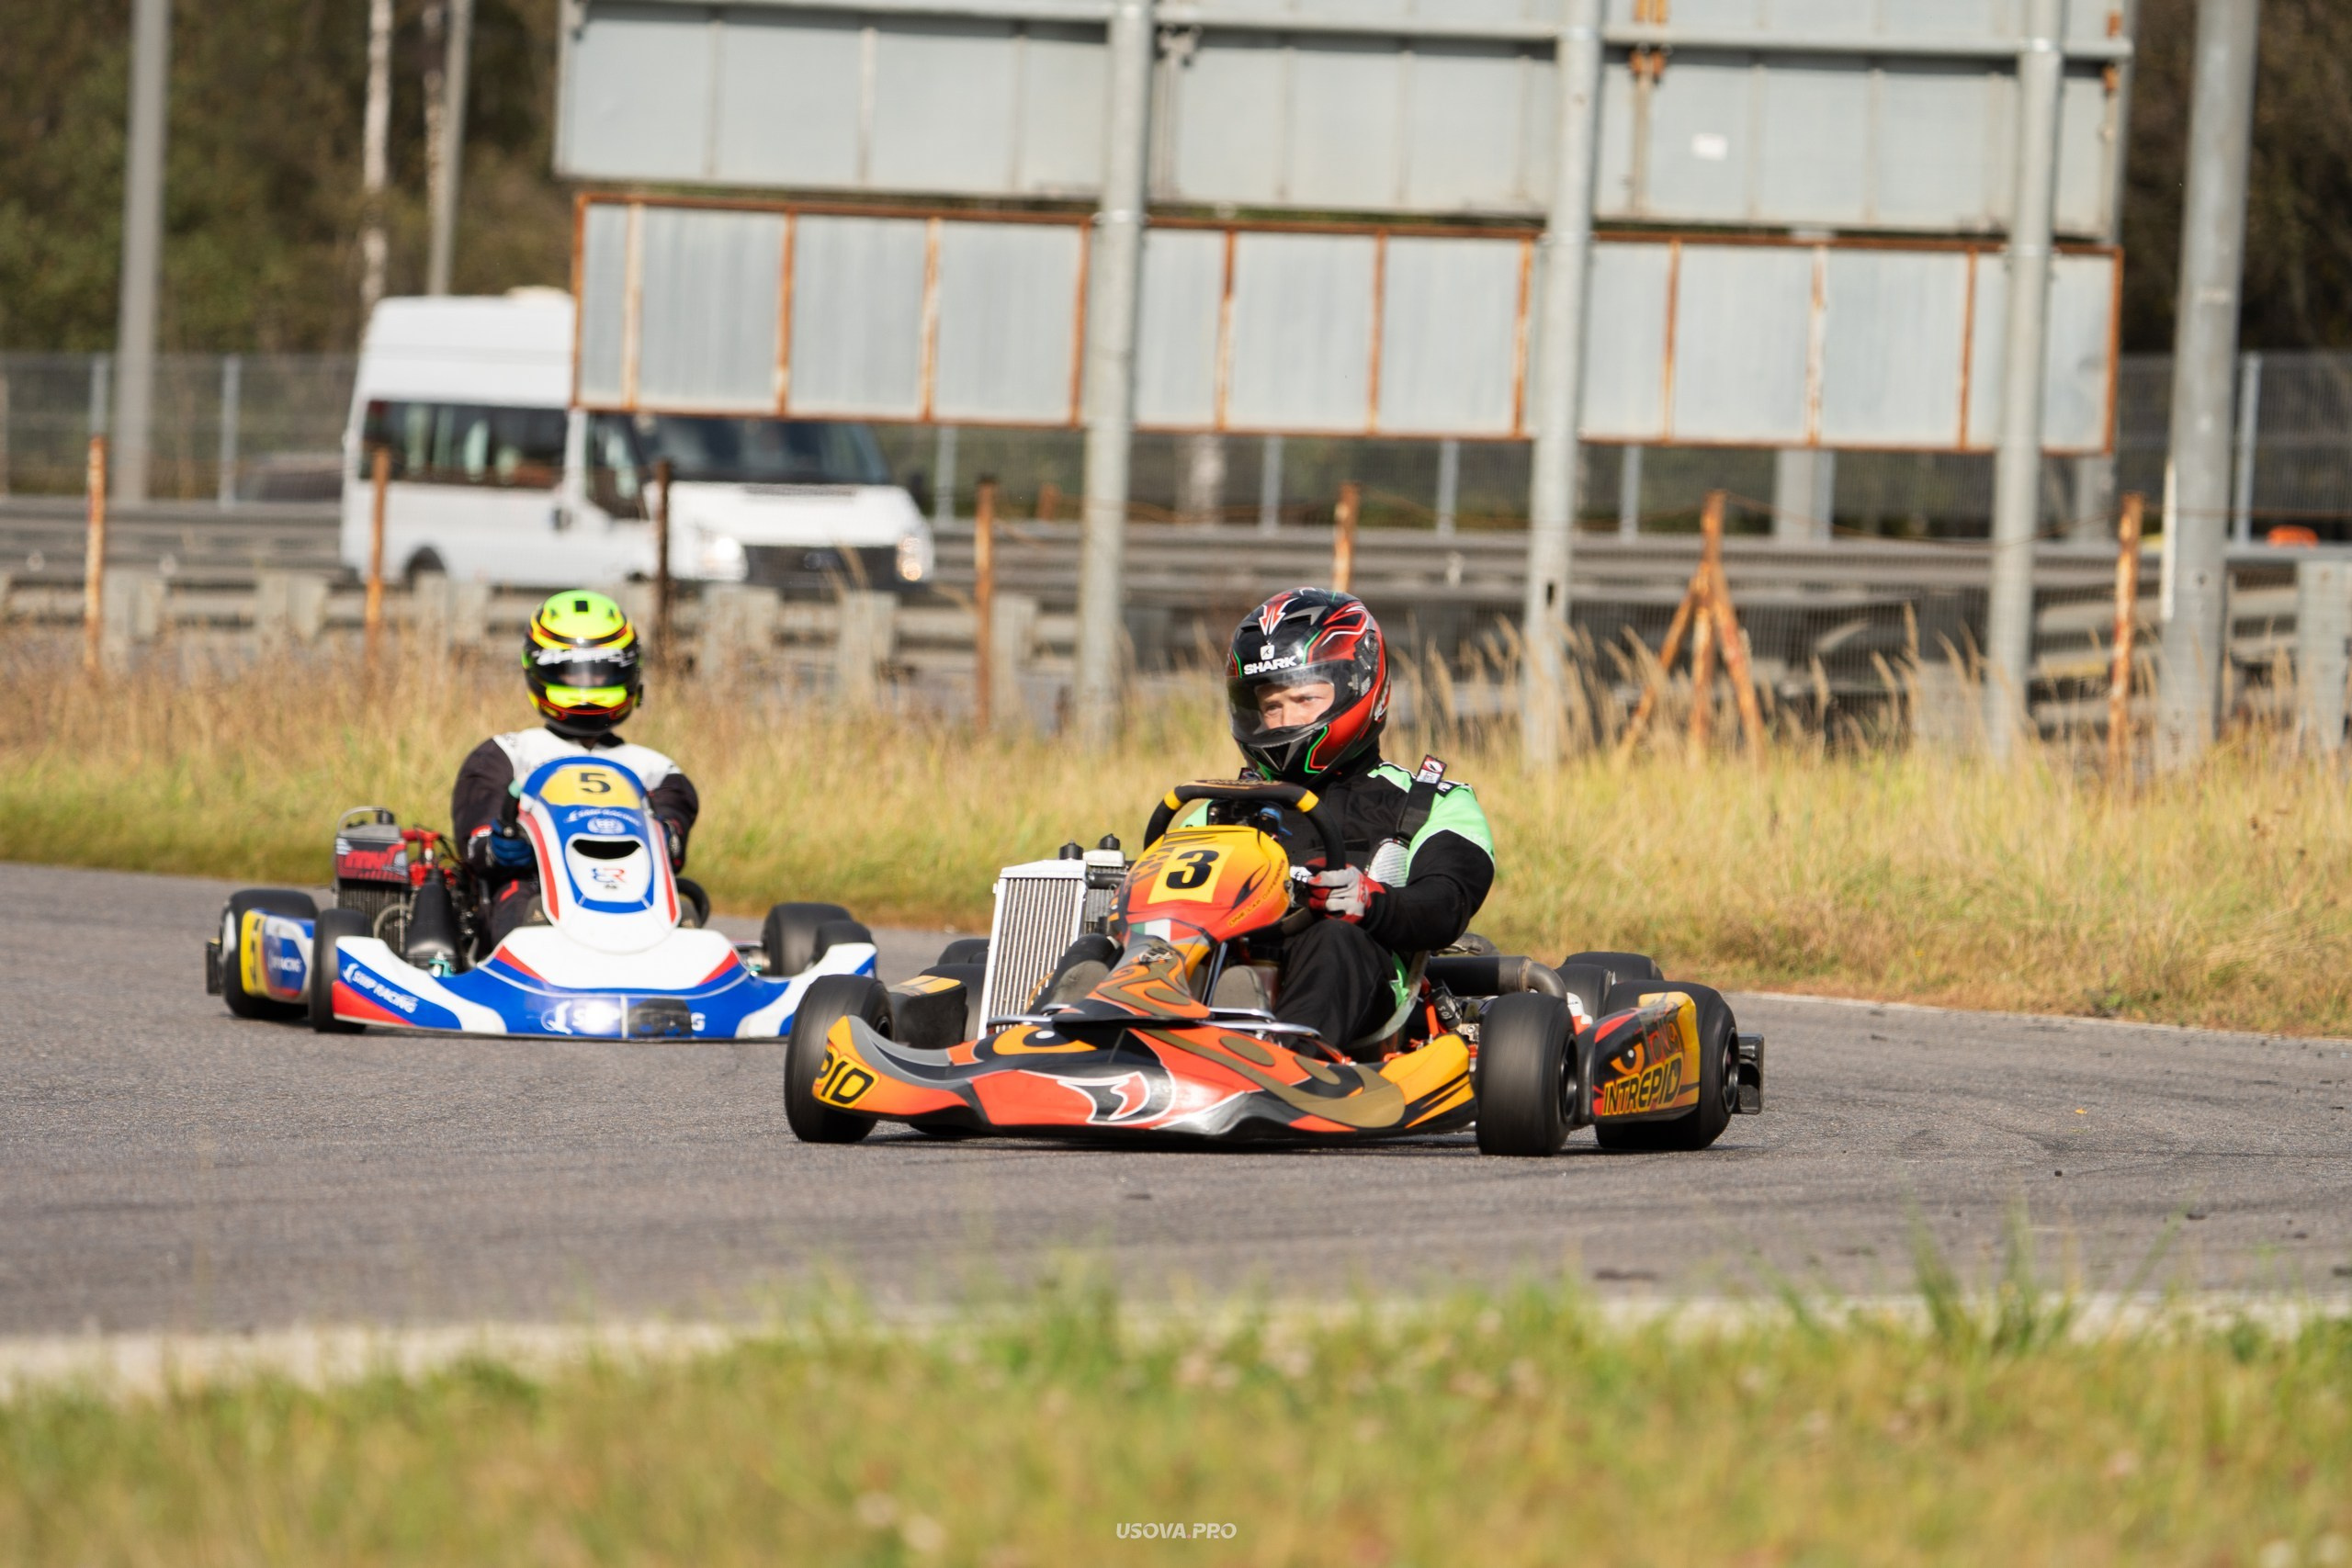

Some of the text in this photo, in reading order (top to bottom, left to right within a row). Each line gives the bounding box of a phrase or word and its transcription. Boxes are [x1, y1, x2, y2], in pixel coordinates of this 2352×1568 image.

[1243, 656, 1296, 675] SHARK
[581, 773, 611, 794] 5
[1166, 850, 1219, 889] 3
[373, 983, 418, 1014] RACING
[1602, 1056, 1683, 1114] INTREPID
